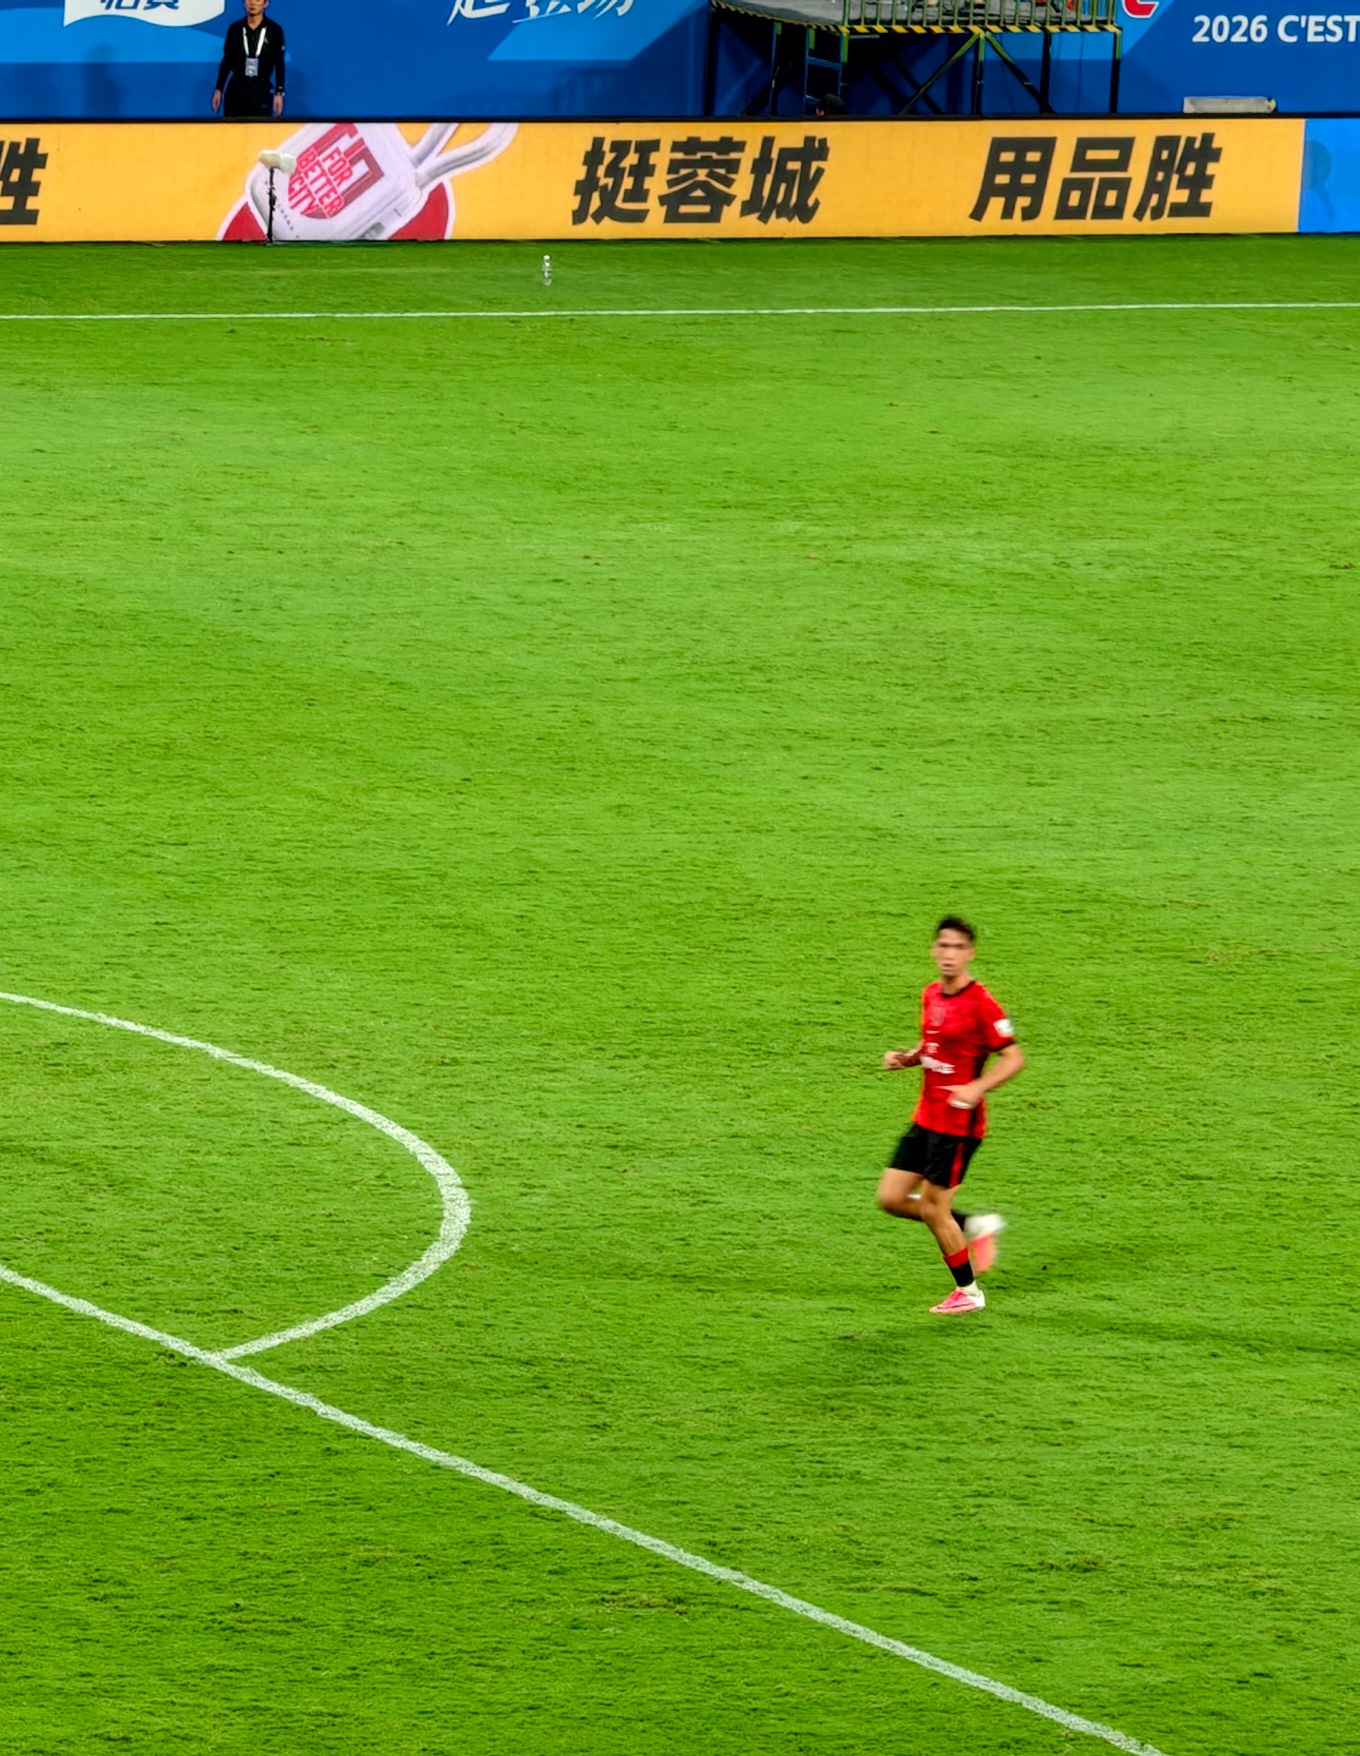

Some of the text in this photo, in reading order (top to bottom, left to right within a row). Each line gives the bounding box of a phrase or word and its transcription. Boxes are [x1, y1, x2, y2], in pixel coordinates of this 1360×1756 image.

[1192, 14, 1268, 43] 2026
[297, 147, 344, 218] BETTER
[322, 146, 353, 188] FOR
[571, 132, 1223, 226] 挺蓉城 用品胜
[288, 172, 322, 216] CITY
